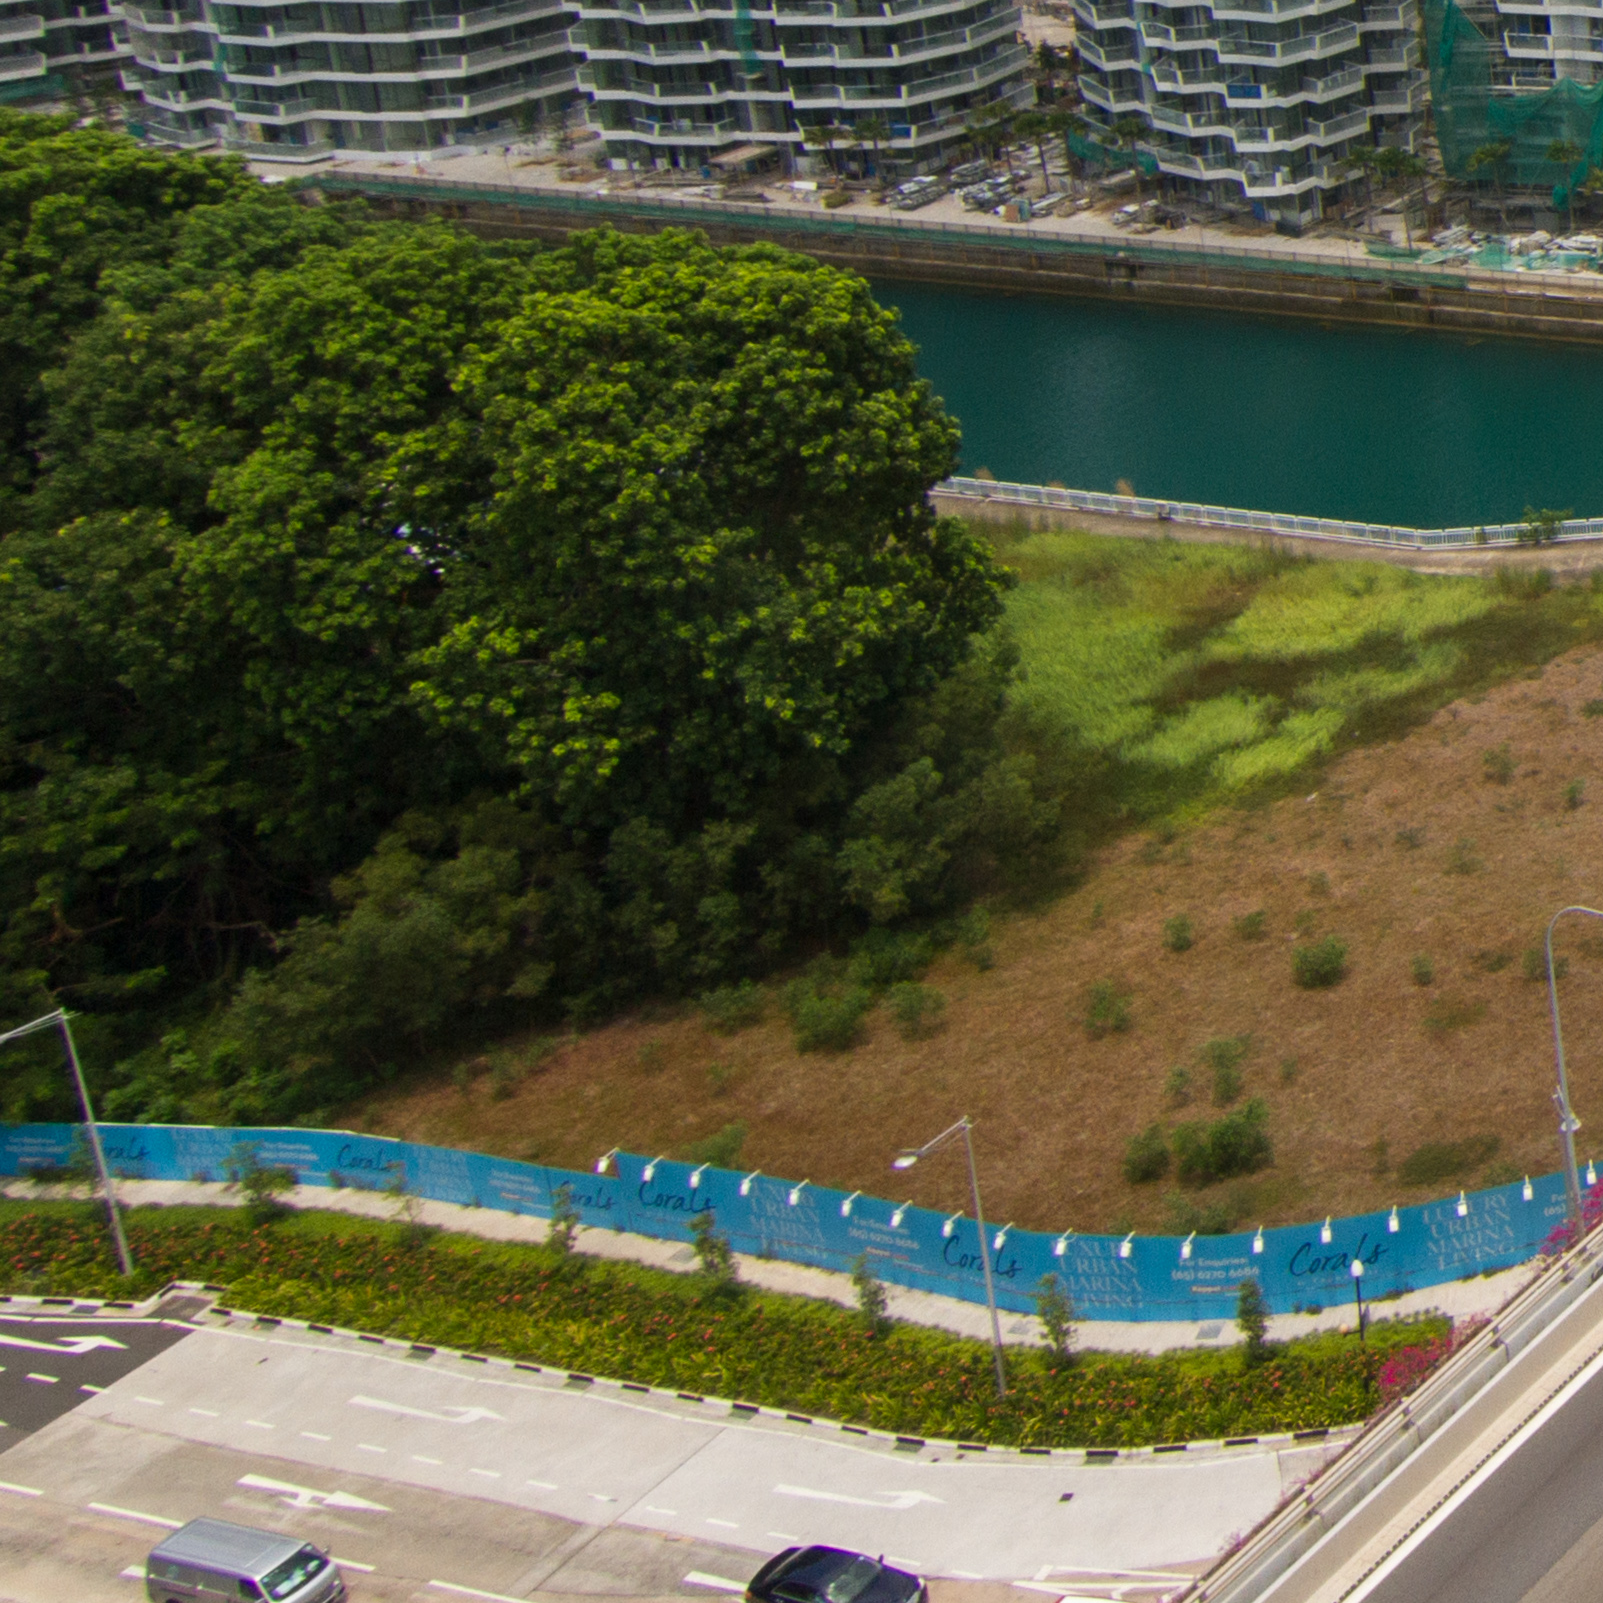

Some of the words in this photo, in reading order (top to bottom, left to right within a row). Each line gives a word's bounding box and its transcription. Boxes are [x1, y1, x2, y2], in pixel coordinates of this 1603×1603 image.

[638, 1179, 717, 1214] Corals
[1423, 1193, 1508, 1225] LUURY
[1427, 1224, 1515, 1255] MARINA
[1431, 1208, 1511, 1239] URBAN
[943, 1234, 1023, 1279] Corals
[1289, 1232, 1390, 1277] Corals
[1171, 1269, 1195, 1281] (65)
[1197, 1269, 1226, 1280] 6270
